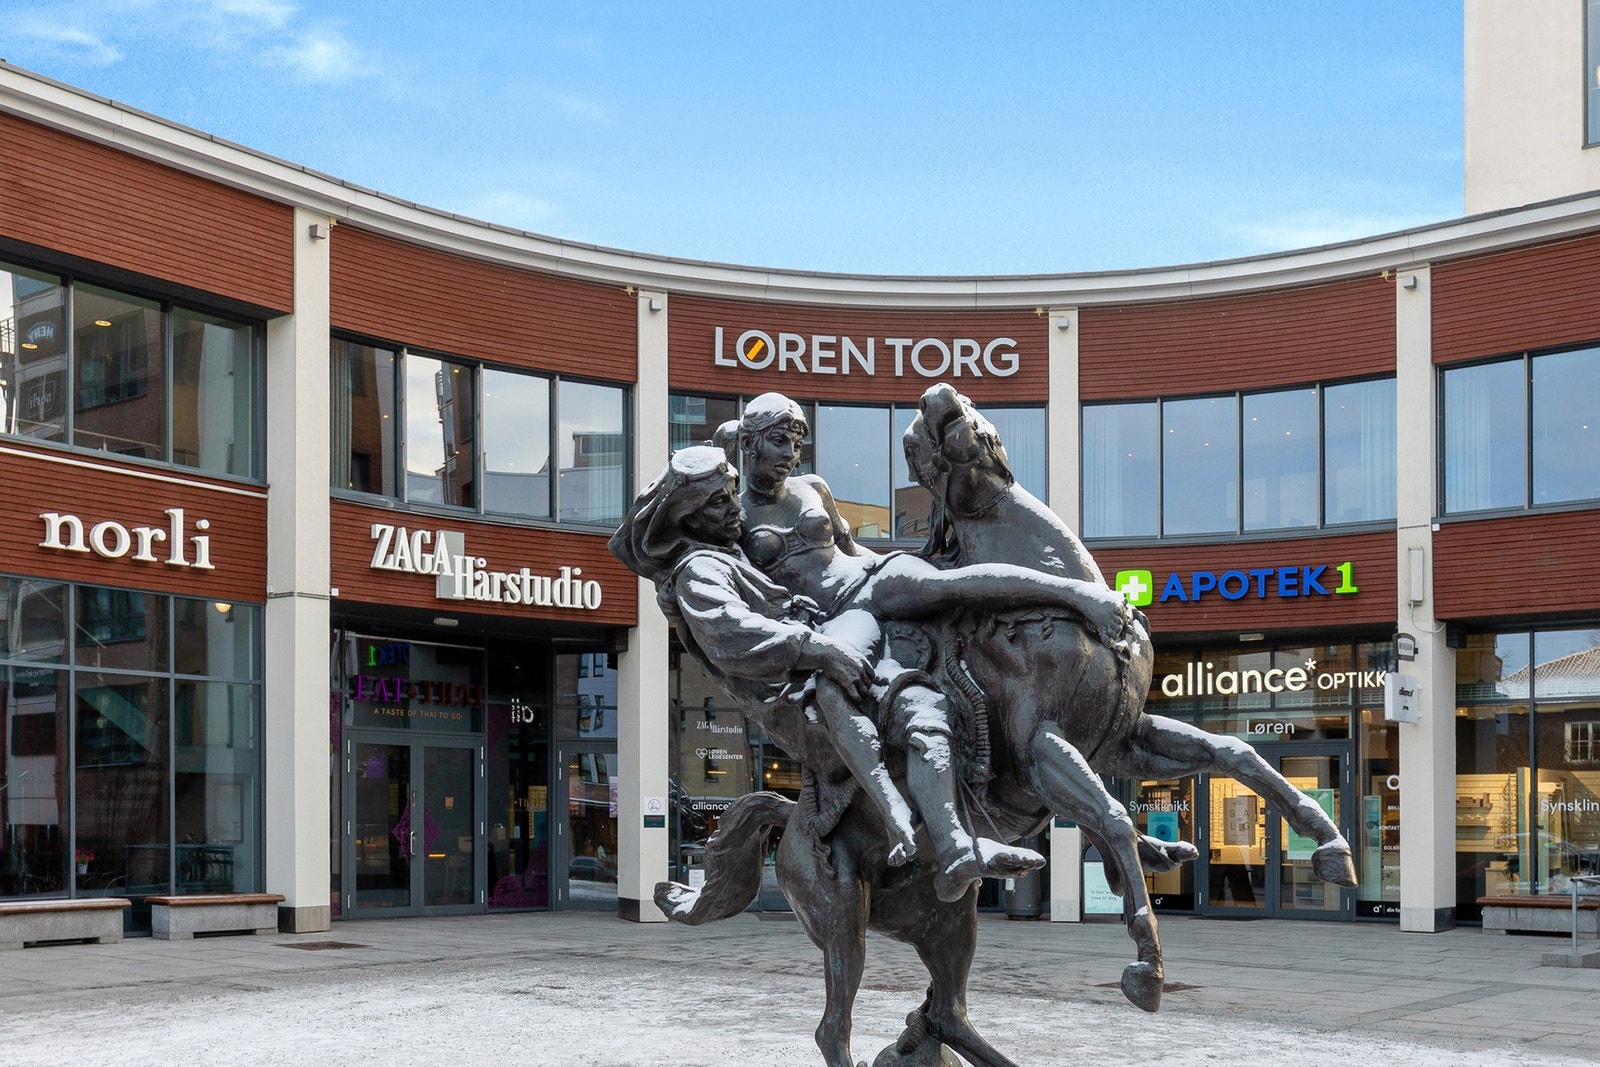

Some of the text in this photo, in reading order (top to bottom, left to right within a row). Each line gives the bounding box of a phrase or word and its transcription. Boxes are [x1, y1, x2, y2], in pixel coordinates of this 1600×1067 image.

[714, 326, 1020, 378] LØREN TORG
[38, 508, 216, 570] norli
[370, 523, 602, 610] ZAGA Hårstudio
[1160, 561, 1360, 602] APOTEK 1
[355, 673, 484, 709] EAT THAI
[1317, 670, 1387, 690] OPTIKK
[373, 707, 462, 720] A TASTE OF THAI TO GO
[1247, 719, 1295, 735] Løren
[1129, 800, 1190, 814] Synsklinikk
